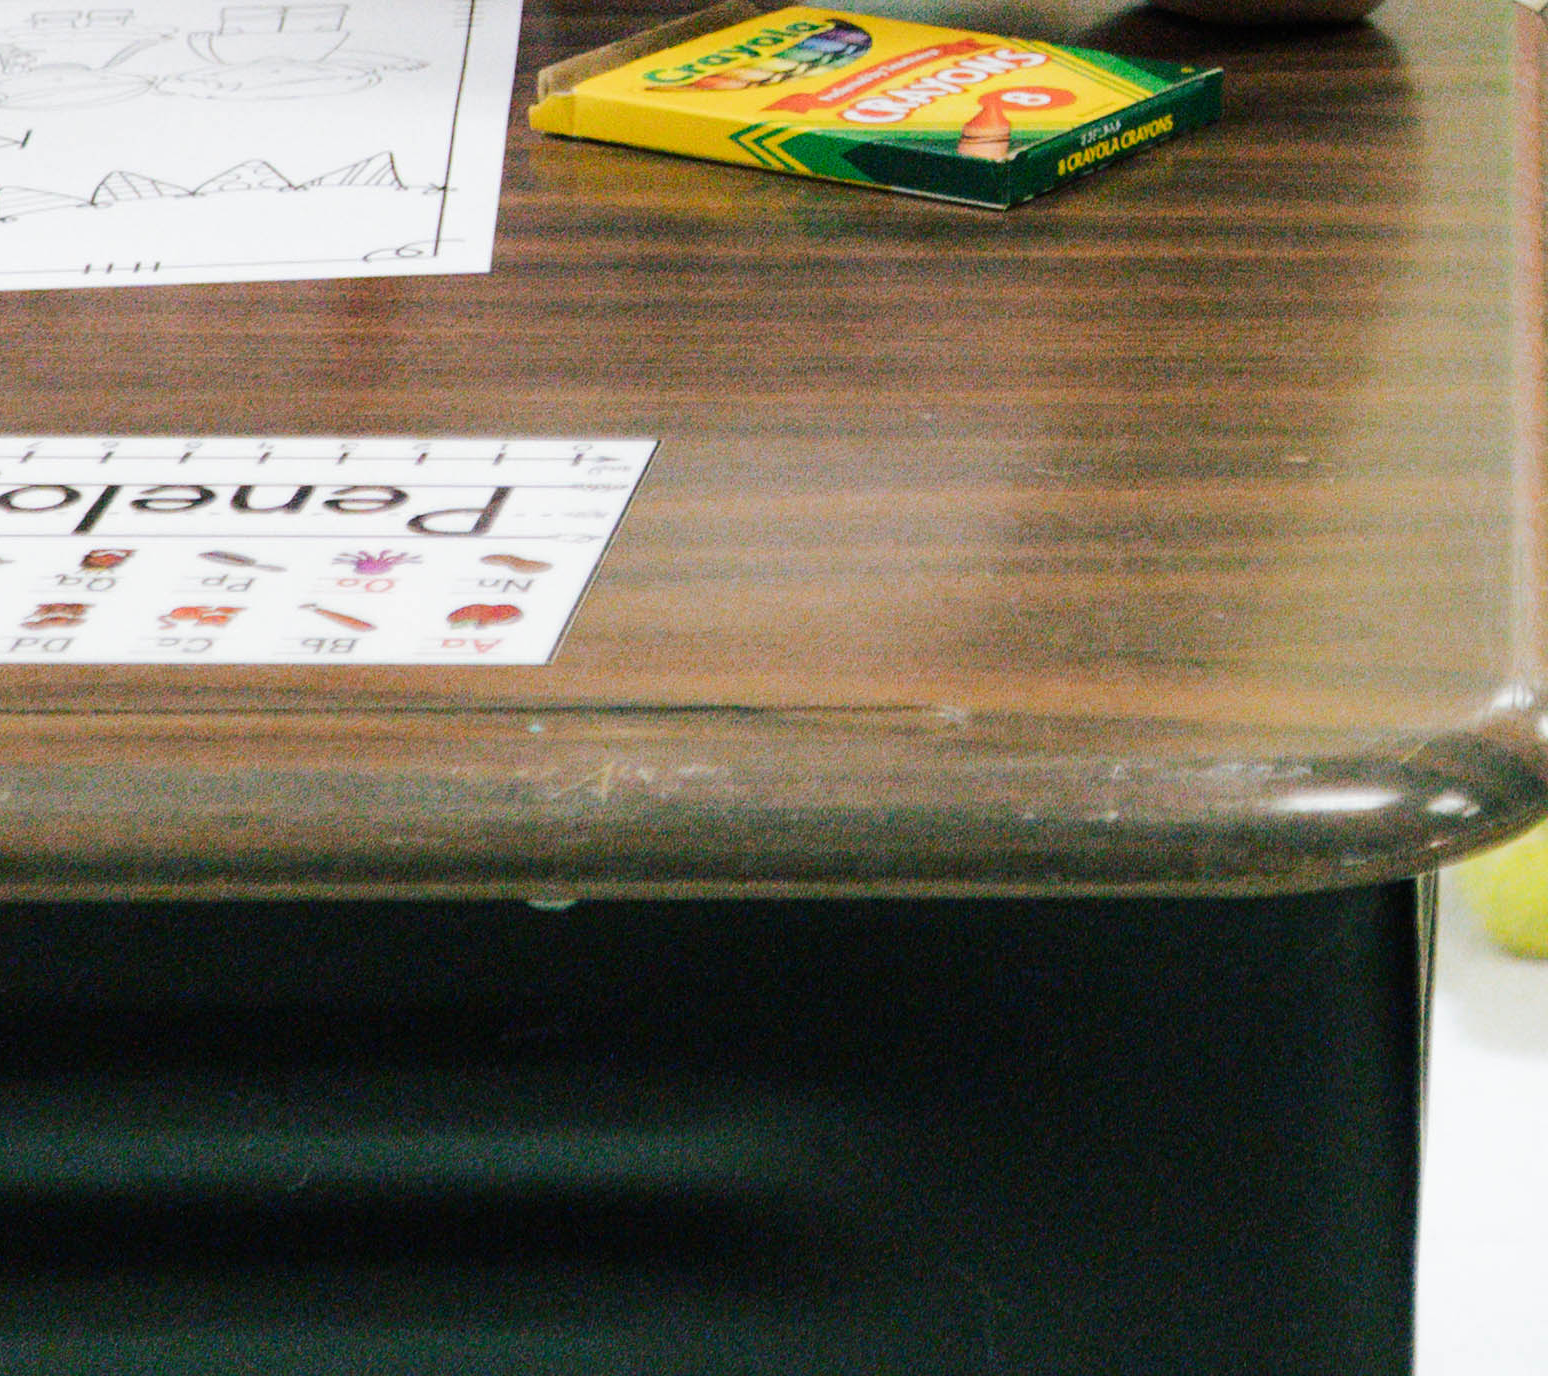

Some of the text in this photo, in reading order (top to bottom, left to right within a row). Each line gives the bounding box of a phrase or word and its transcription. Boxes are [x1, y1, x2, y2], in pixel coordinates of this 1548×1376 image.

[643, 19, 822, 84] Crayola
[841, 48, 1047, 123] CRAYONS
[1001, 90, 1052, 107] 8
[1066, 136, 1120, 173] CRAYOLA
[1120, 114, 1174, 148] CRAYONS
[55, 573, 116, 592] Qq
[201, 574, 256, 592] Pp
[336, 578, 396, 593] Oo
[478, 578, 535, 593] Nn
[9, 637, 74, 653] Dd
[156, 637, 214, 653] Cc
[301, 638, 359, 654] Bb
[441, 638, 502, 655] Aa
